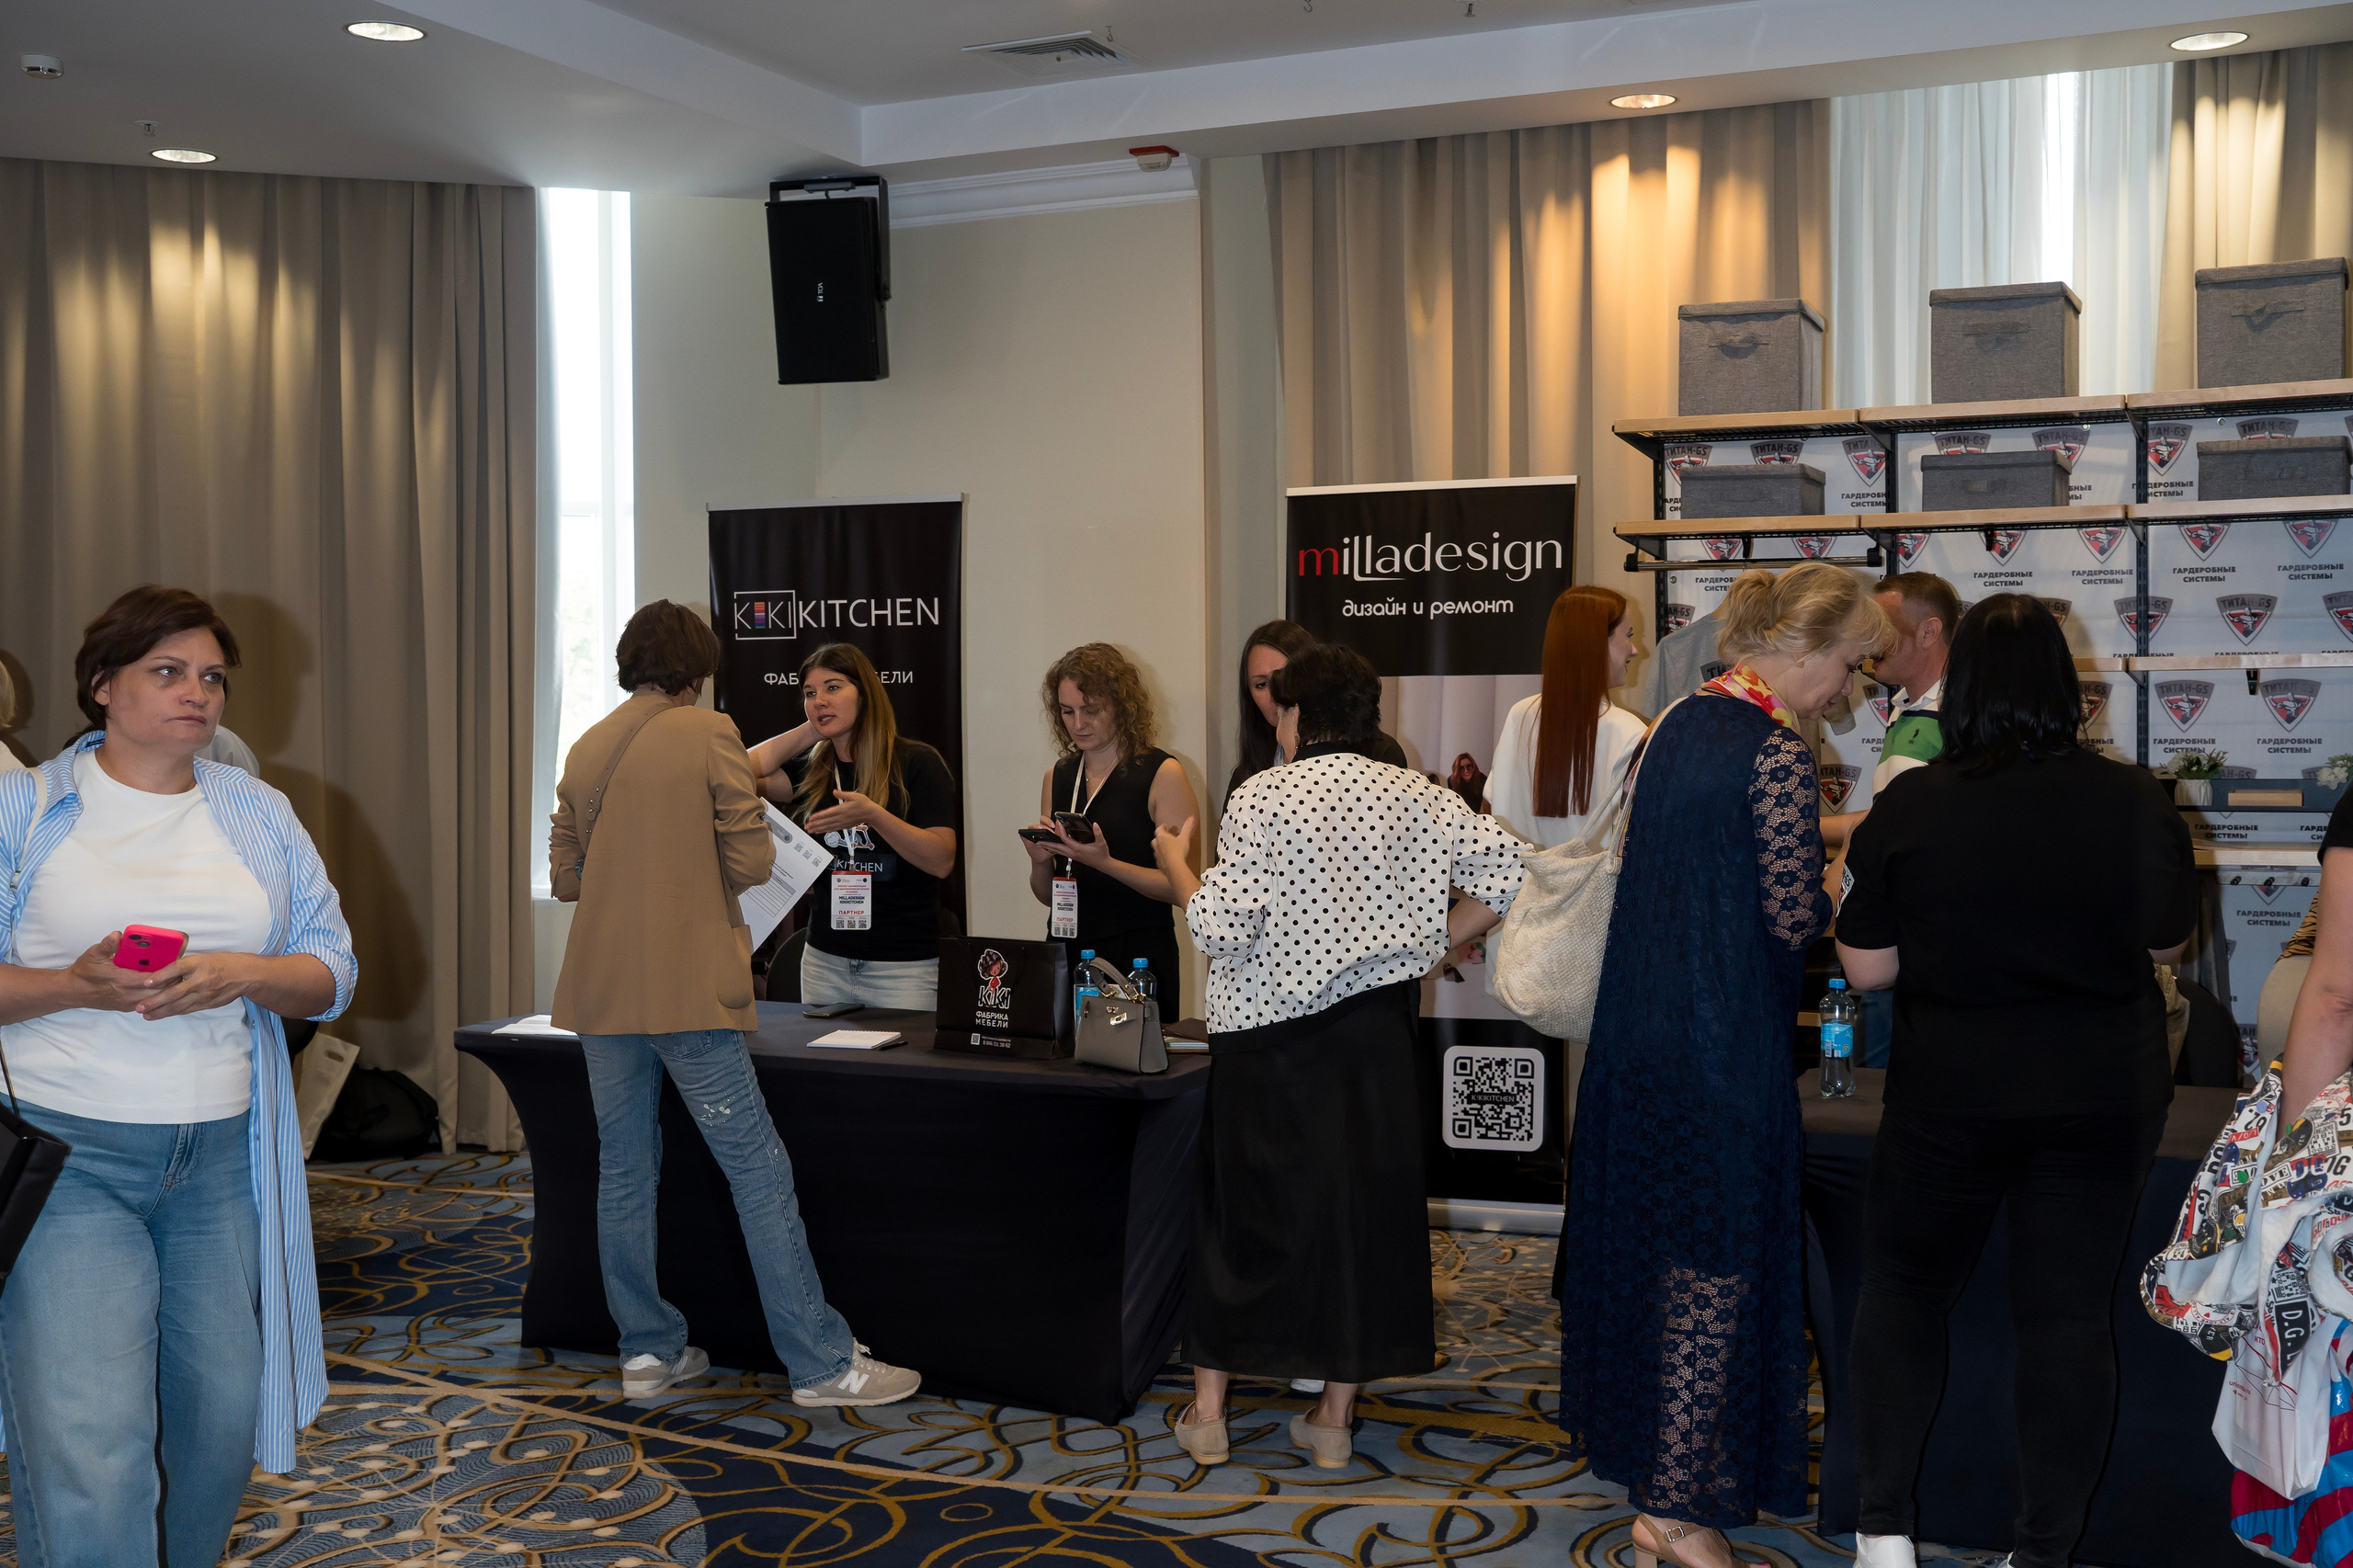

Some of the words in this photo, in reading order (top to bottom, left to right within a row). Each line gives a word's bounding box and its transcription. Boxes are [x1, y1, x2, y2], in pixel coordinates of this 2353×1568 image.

[2151, 426, 2188, 437] ТАН-GS
[1754, 442, 1800, 455] ТИТАН-GS
[1841, 492, 1886, 500] ГАРДЕРОБН
[2147, 490, 2184, 498] ИСТЕМЫ
[1298, 531, 1563, 582] milladesign
[2172, 566, 2236, 574] ГАРДЕРОБНЫЕ
[2278, 562, 2345, 572] ГАРДЕРОБНЫЕ
[1973, 571, 2033, 579] ГАРДЕРОБНЫЕ
[2071, 569, 2134, 577] ГАРДЕРОБНЫЕ
[1695, 576, 1736, 585] ГАРДЕРОБ
[799, 597, 939, 628] KITCHEN
[1342, 597, 1406, 618] дизайн
[1413, 600, 1424, 615] и
[1429, 599, 1514, 620] ремонт
[2159, 683, 2210, 695] ТИТАН-GS
[2194, 824, 2258, 832] ГАРДЕРОБНЫЕ
[2236, 909, 2302, 918] ГАРДЕРОБНЫЕ
[977, 985, 1011, 1010] KIKI
[975, 1010, 1009, 1021] ФАБРИКА
[975, 1018, 1008, 1028] МЕБЕЛИ
